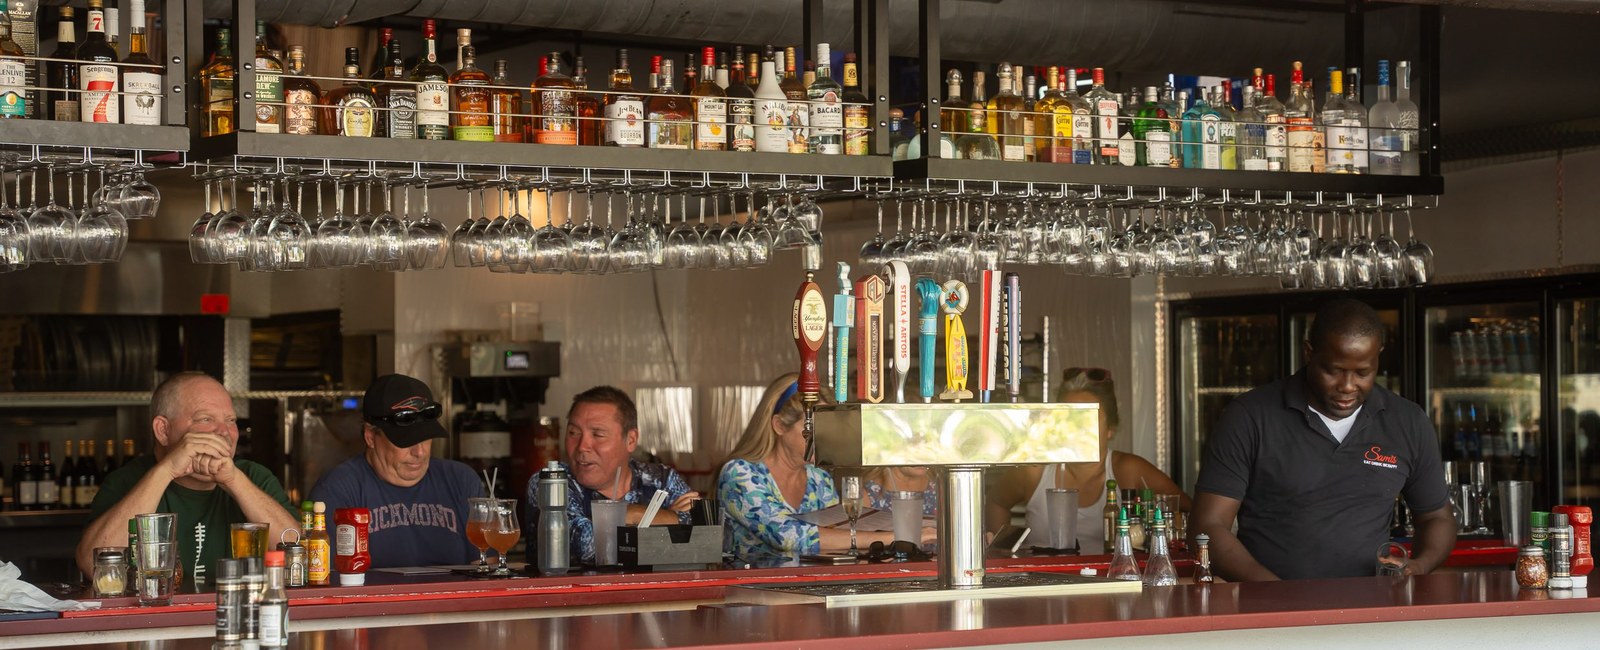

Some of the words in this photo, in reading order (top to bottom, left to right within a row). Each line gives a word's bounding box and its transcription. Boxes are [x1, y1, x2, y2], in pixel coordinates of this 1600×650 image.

[93, 17, 102, 31] 7
[7, 76, 16, 84] 12
[418, 84, 449, 94] JAMESO
[617, 107, 628, 117] JIM
[817, 107, 841, 115] BACARD
[368, 502, 458, 534] RICHMOND
